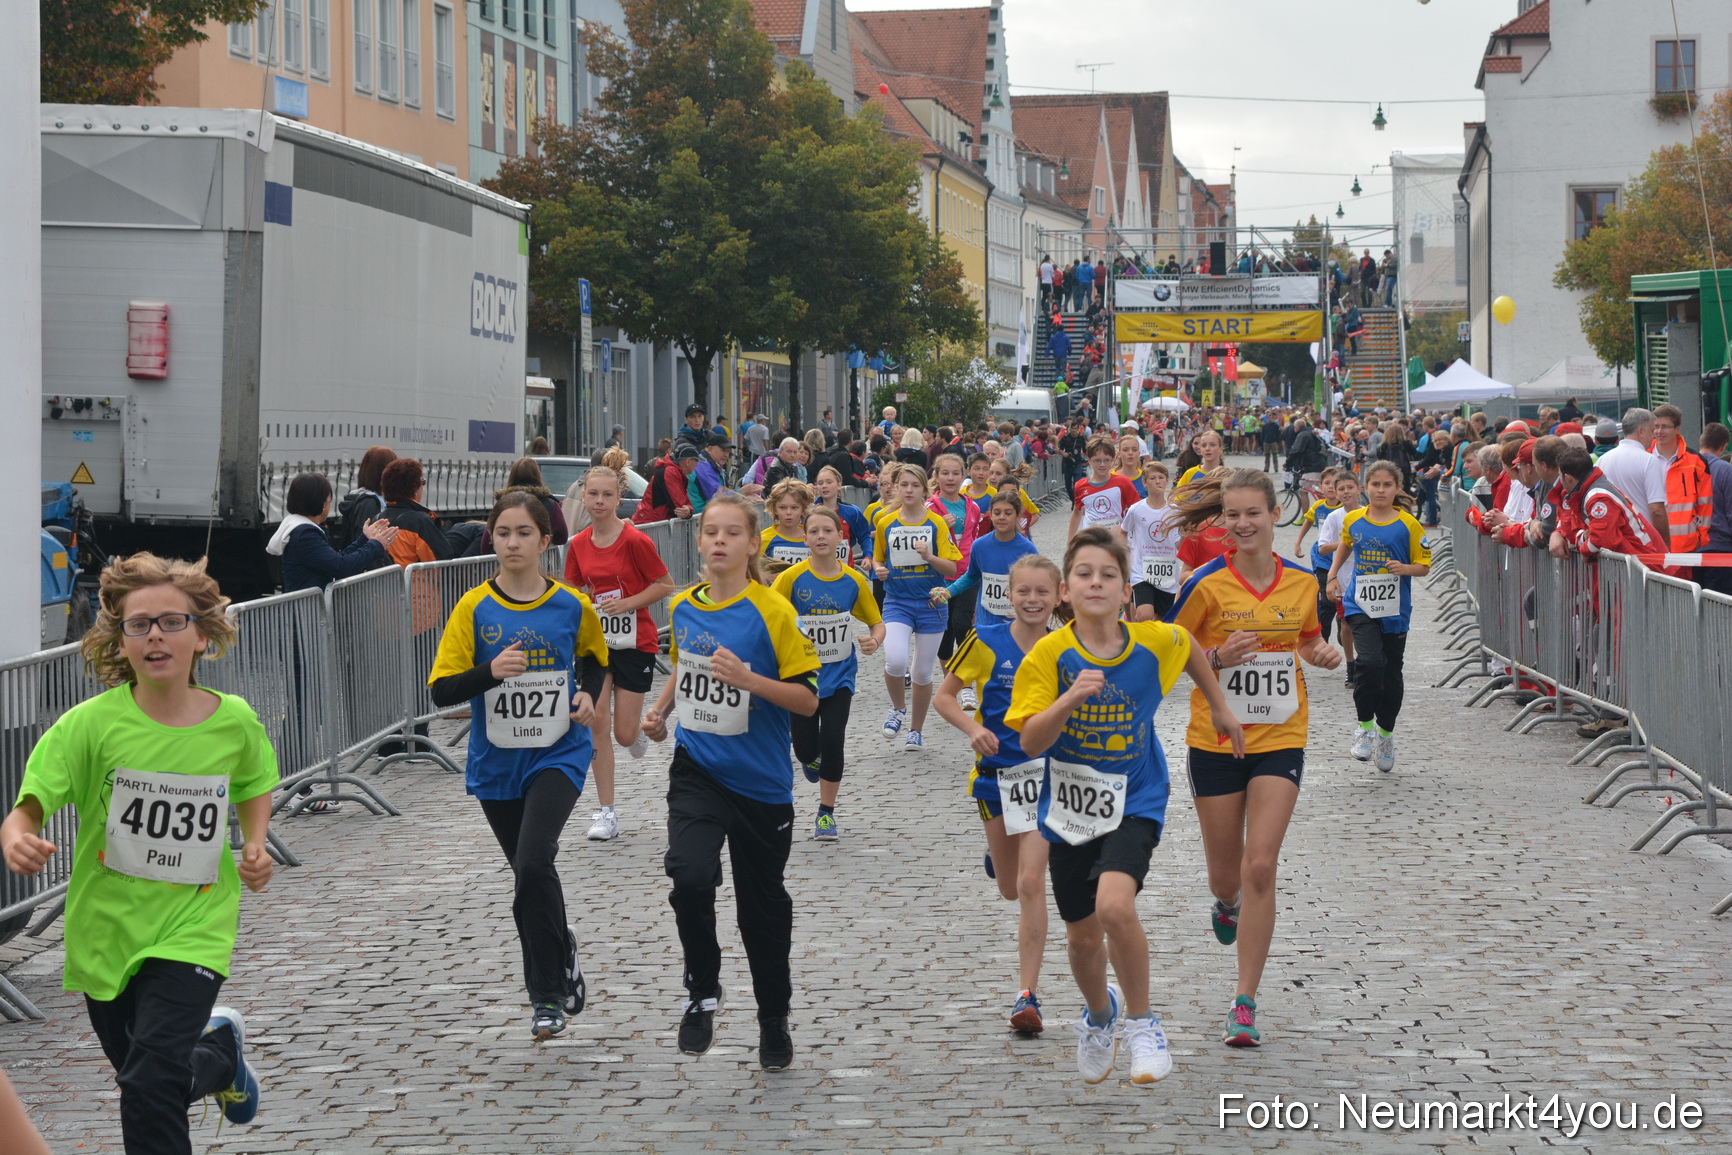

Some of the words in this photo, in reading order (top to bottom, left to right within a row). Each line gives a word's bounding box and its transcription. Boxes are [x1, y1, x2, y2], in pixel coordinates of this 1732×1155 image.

[581, 284, 588, 310] P
[470, 272, 517, 344] BOCK
[1183, 318, 1254, 335] START
[1227, 348, 1237, 356] 32
[1146, 564, 1173, 577] 4003
[1360, 584, 1396, 601] 4022
[1221, 609, 1255, 621] Deyerl
[600, 616, 632, 634] 008
[808, 624, 848, 645] 4017
[817, 648, 839, 657] Judith
[1250, 659, 1284, 667] Neumarkt
[514, 680, 553, 688] Neumarkt
[680, 671, 741, 708] 4035
[1227, 670, 1290, 697] 4015
[494, 690, 560, 719] 4027
[1247, 703, 1271, 716] Lucy
[693, 708, 718, 724] Elisa
[513, 726, 543, 738] Linda
[1000, 771, 1023, 781] PARTL
[1023, 767, 1045, 777] Neum
[1071, 772, 1110, 787] Neumarkt
[116, 777, 156, 793] PARTL
[158, 784, 213, 797] Neumarkt
[1009, 778, 1044, 807] 40
[1057, 781, 1115, 819] 4023
[120, 797, 218, 842] 4039
[1025, 811, 1037, 822] Ja
[1062, 820, 1098, 838] Jannick
[146, 849, 182, 867] Paul
